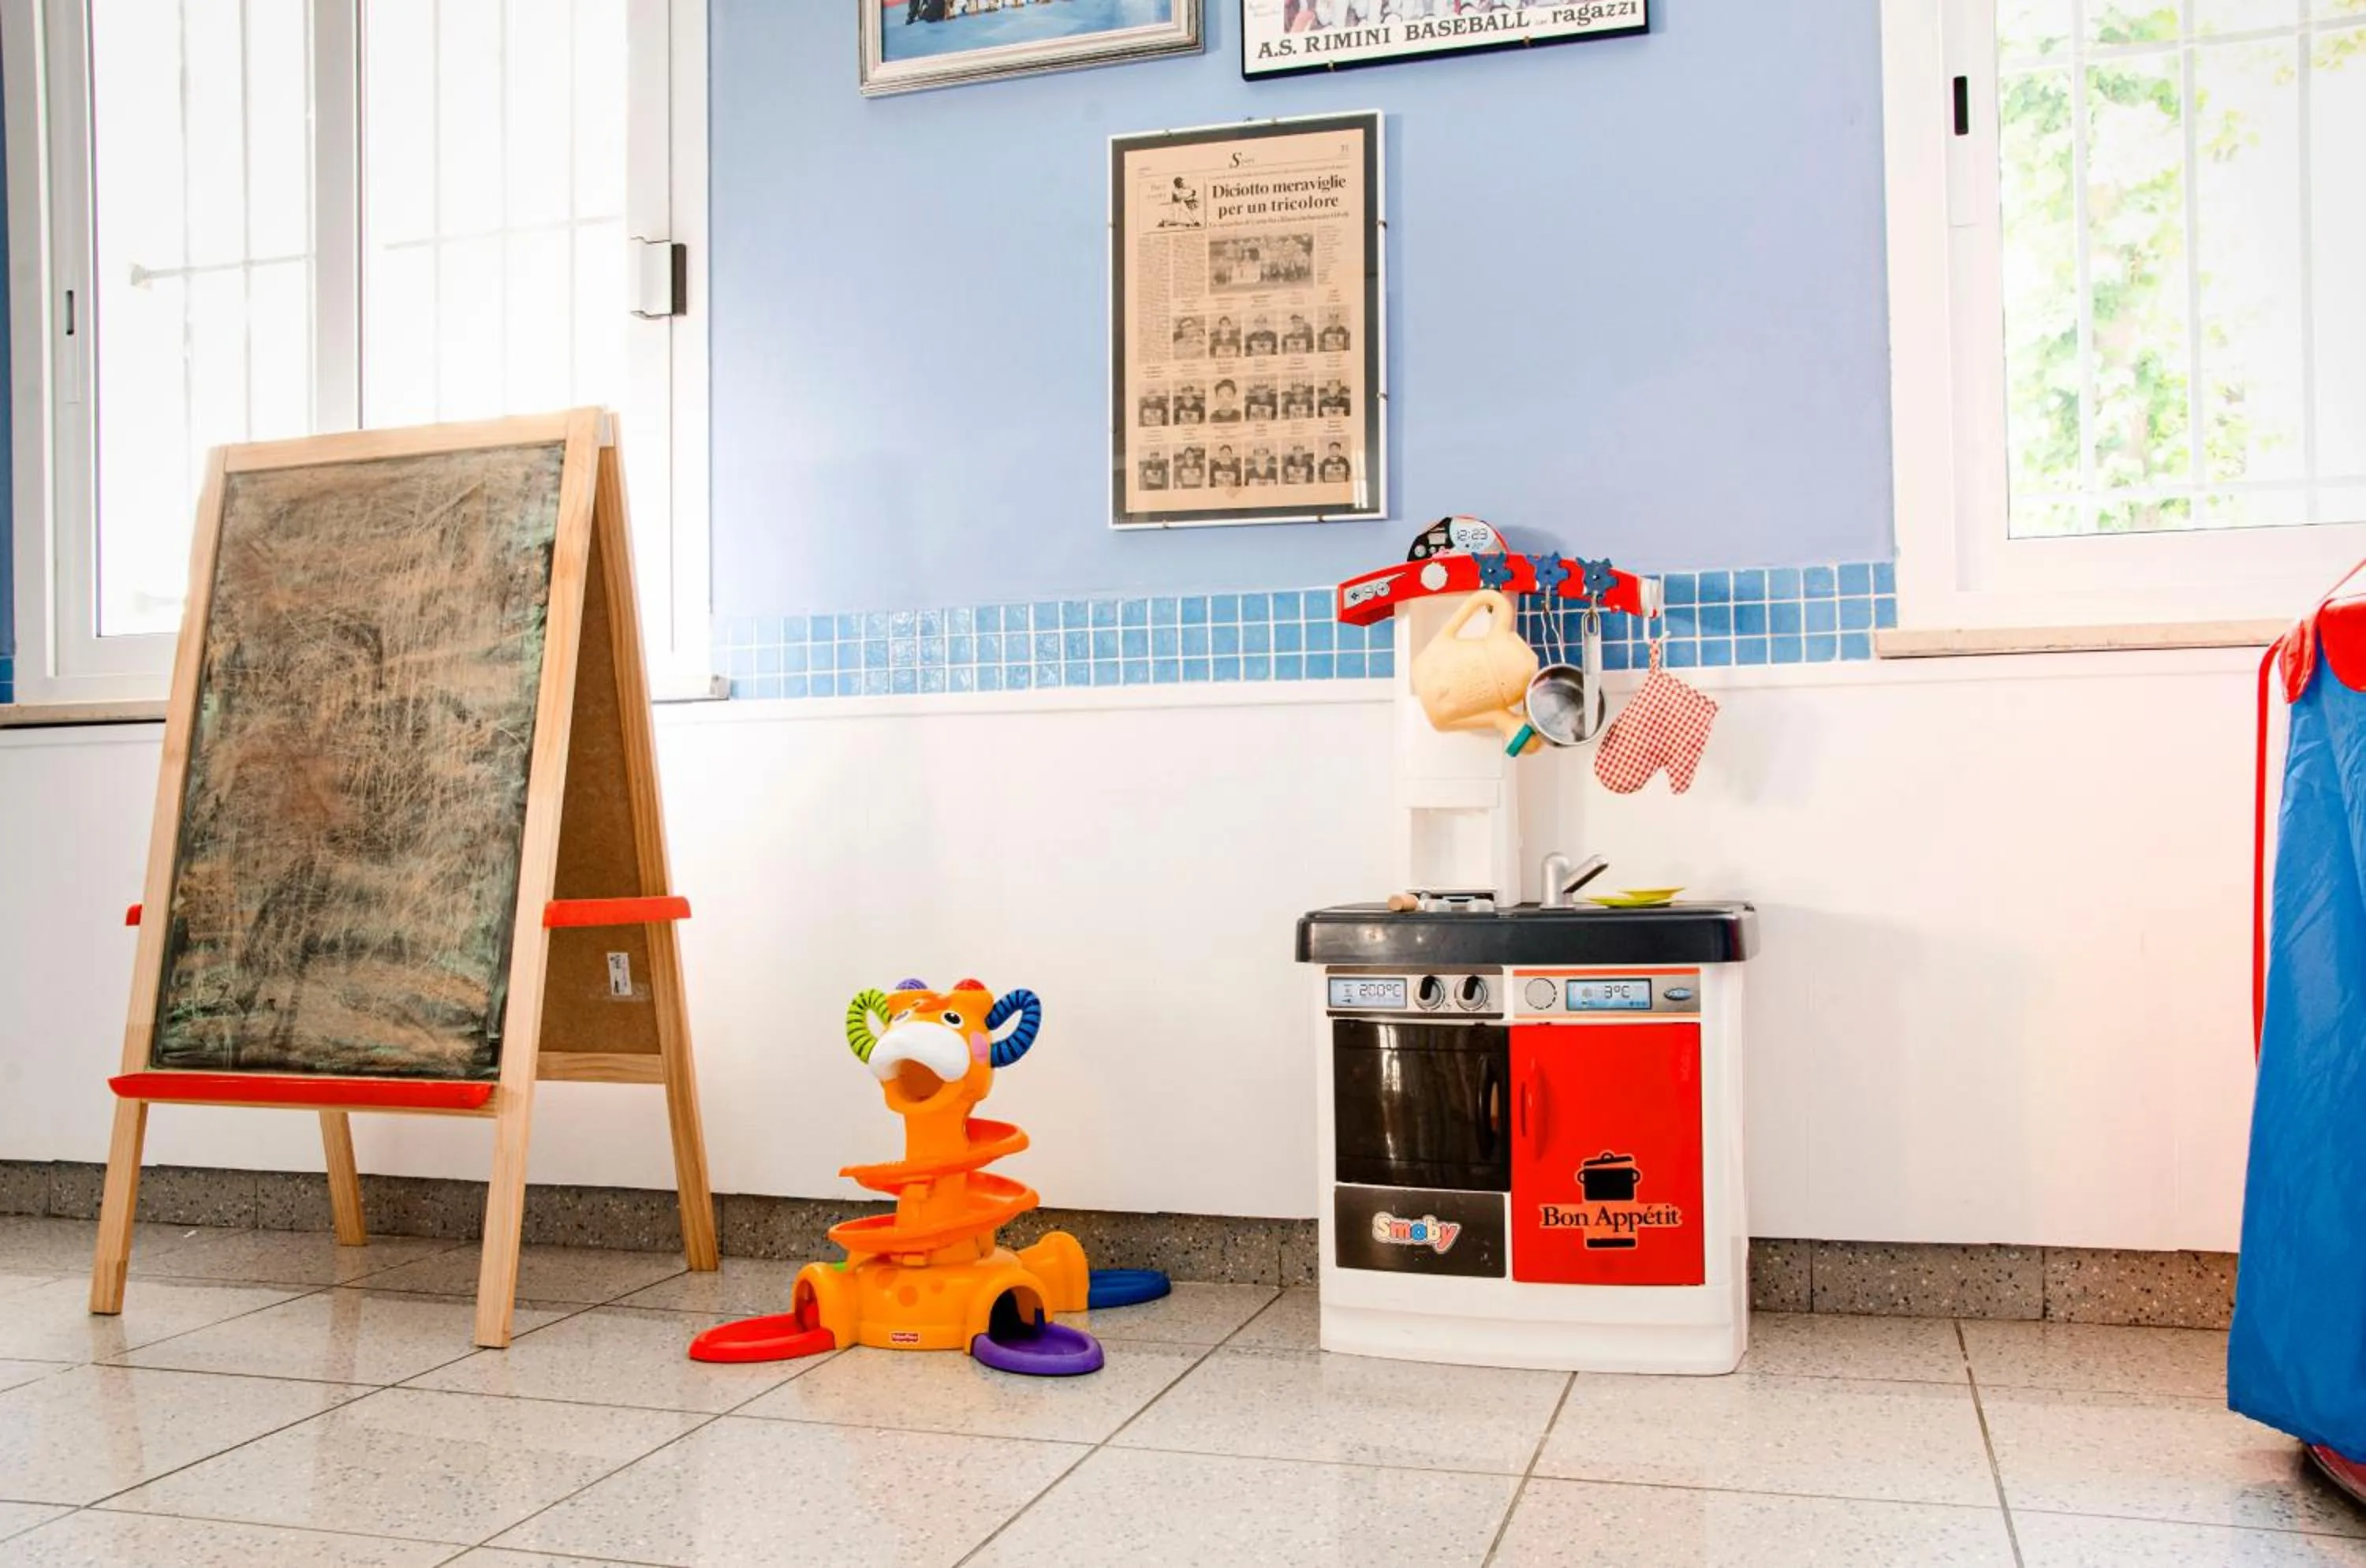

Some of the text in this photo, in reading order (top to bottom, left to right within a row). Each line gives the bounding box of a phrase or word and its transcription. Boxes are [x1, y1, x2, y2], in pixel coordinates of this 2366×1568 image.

[1257, 2, 1637, 59] A.S. RIMINI BASEBALL ragazzi
[1212, 174, 1347, 199] Diciotto meraviglie
[1218, 196, 1339, 220] per un tricolore
[1374, 1212, 1460, 1253] Smoby
[1542, 1204, 1679, 1234] Bon Appétit
